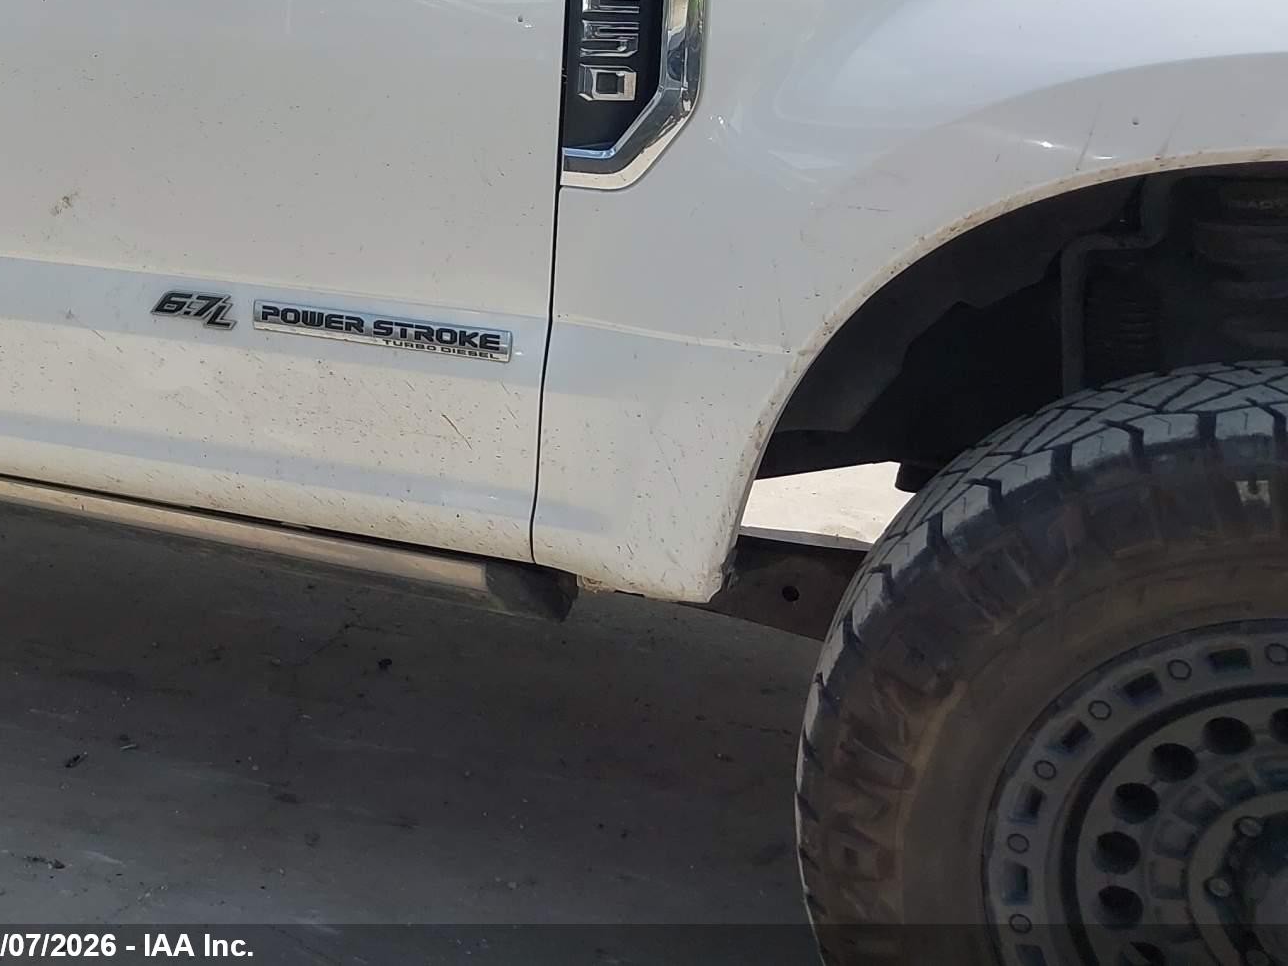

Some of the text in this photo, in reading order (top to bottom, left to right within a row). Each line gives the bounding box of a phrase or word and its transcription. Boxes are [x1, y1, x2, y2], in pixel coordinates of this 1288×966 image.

[152, 290, 501, 351] 6.7L POWER STROKE
[382, 338, 500, 360] TURBO DIESEL
